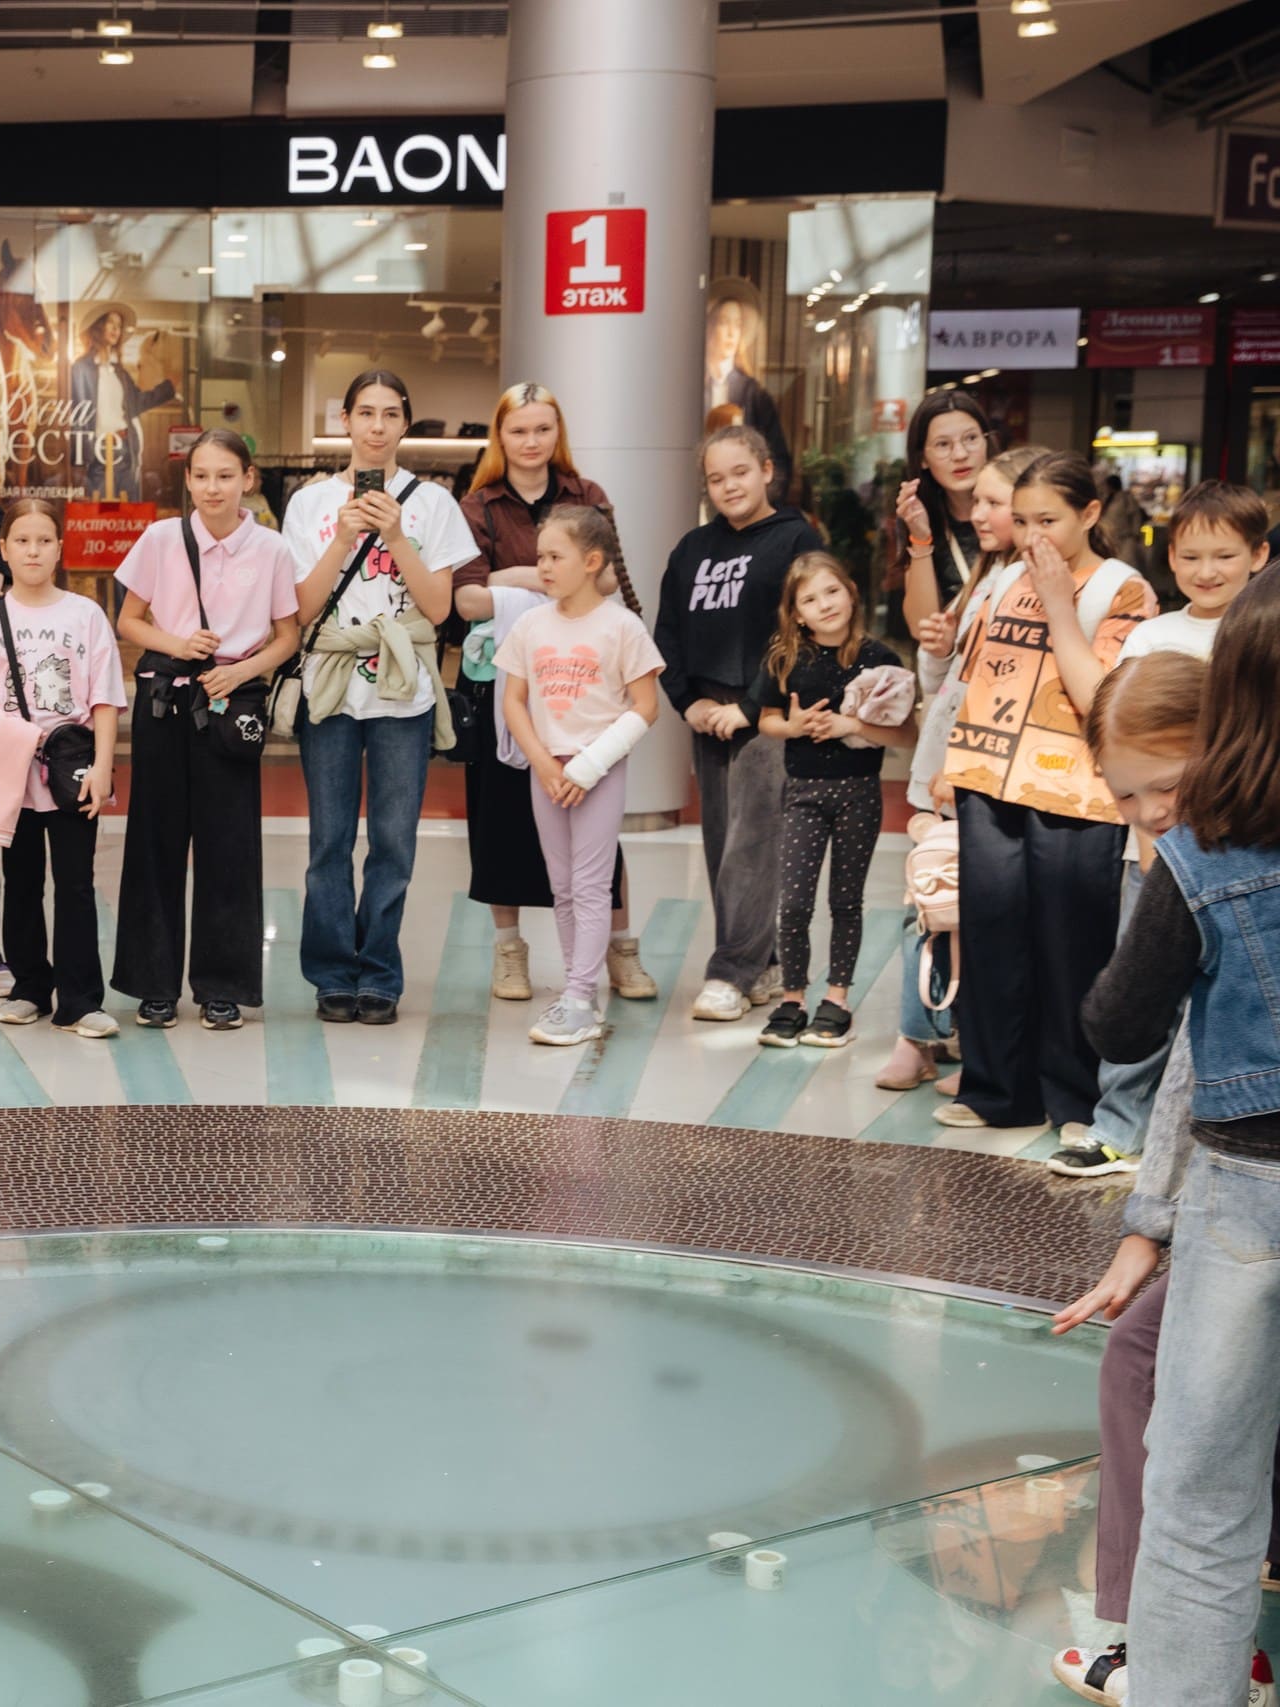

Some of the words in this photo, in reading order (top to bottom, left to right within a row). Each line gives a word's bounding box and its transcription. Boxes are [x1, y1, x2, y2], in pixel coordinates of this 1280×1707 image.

[287, 133, 507, 194] BAON
[569, 214, 621, 284] 1
[561, 286, 628, 308] этаж
[946, 328, 1058, 348] АВРОРА
[0, 486, 21, 498] ВАЯ
[22, 485, 86, 499] КОЛЛЕКЦИЯ
[82, 540, 106, 556] ДО
[688, 579, 745, 612] PLAY
[987, 621, 1044, 646] GIVE
[986, 658, 1017, 677] YES
[947, 727, 1012, 756] OVER
